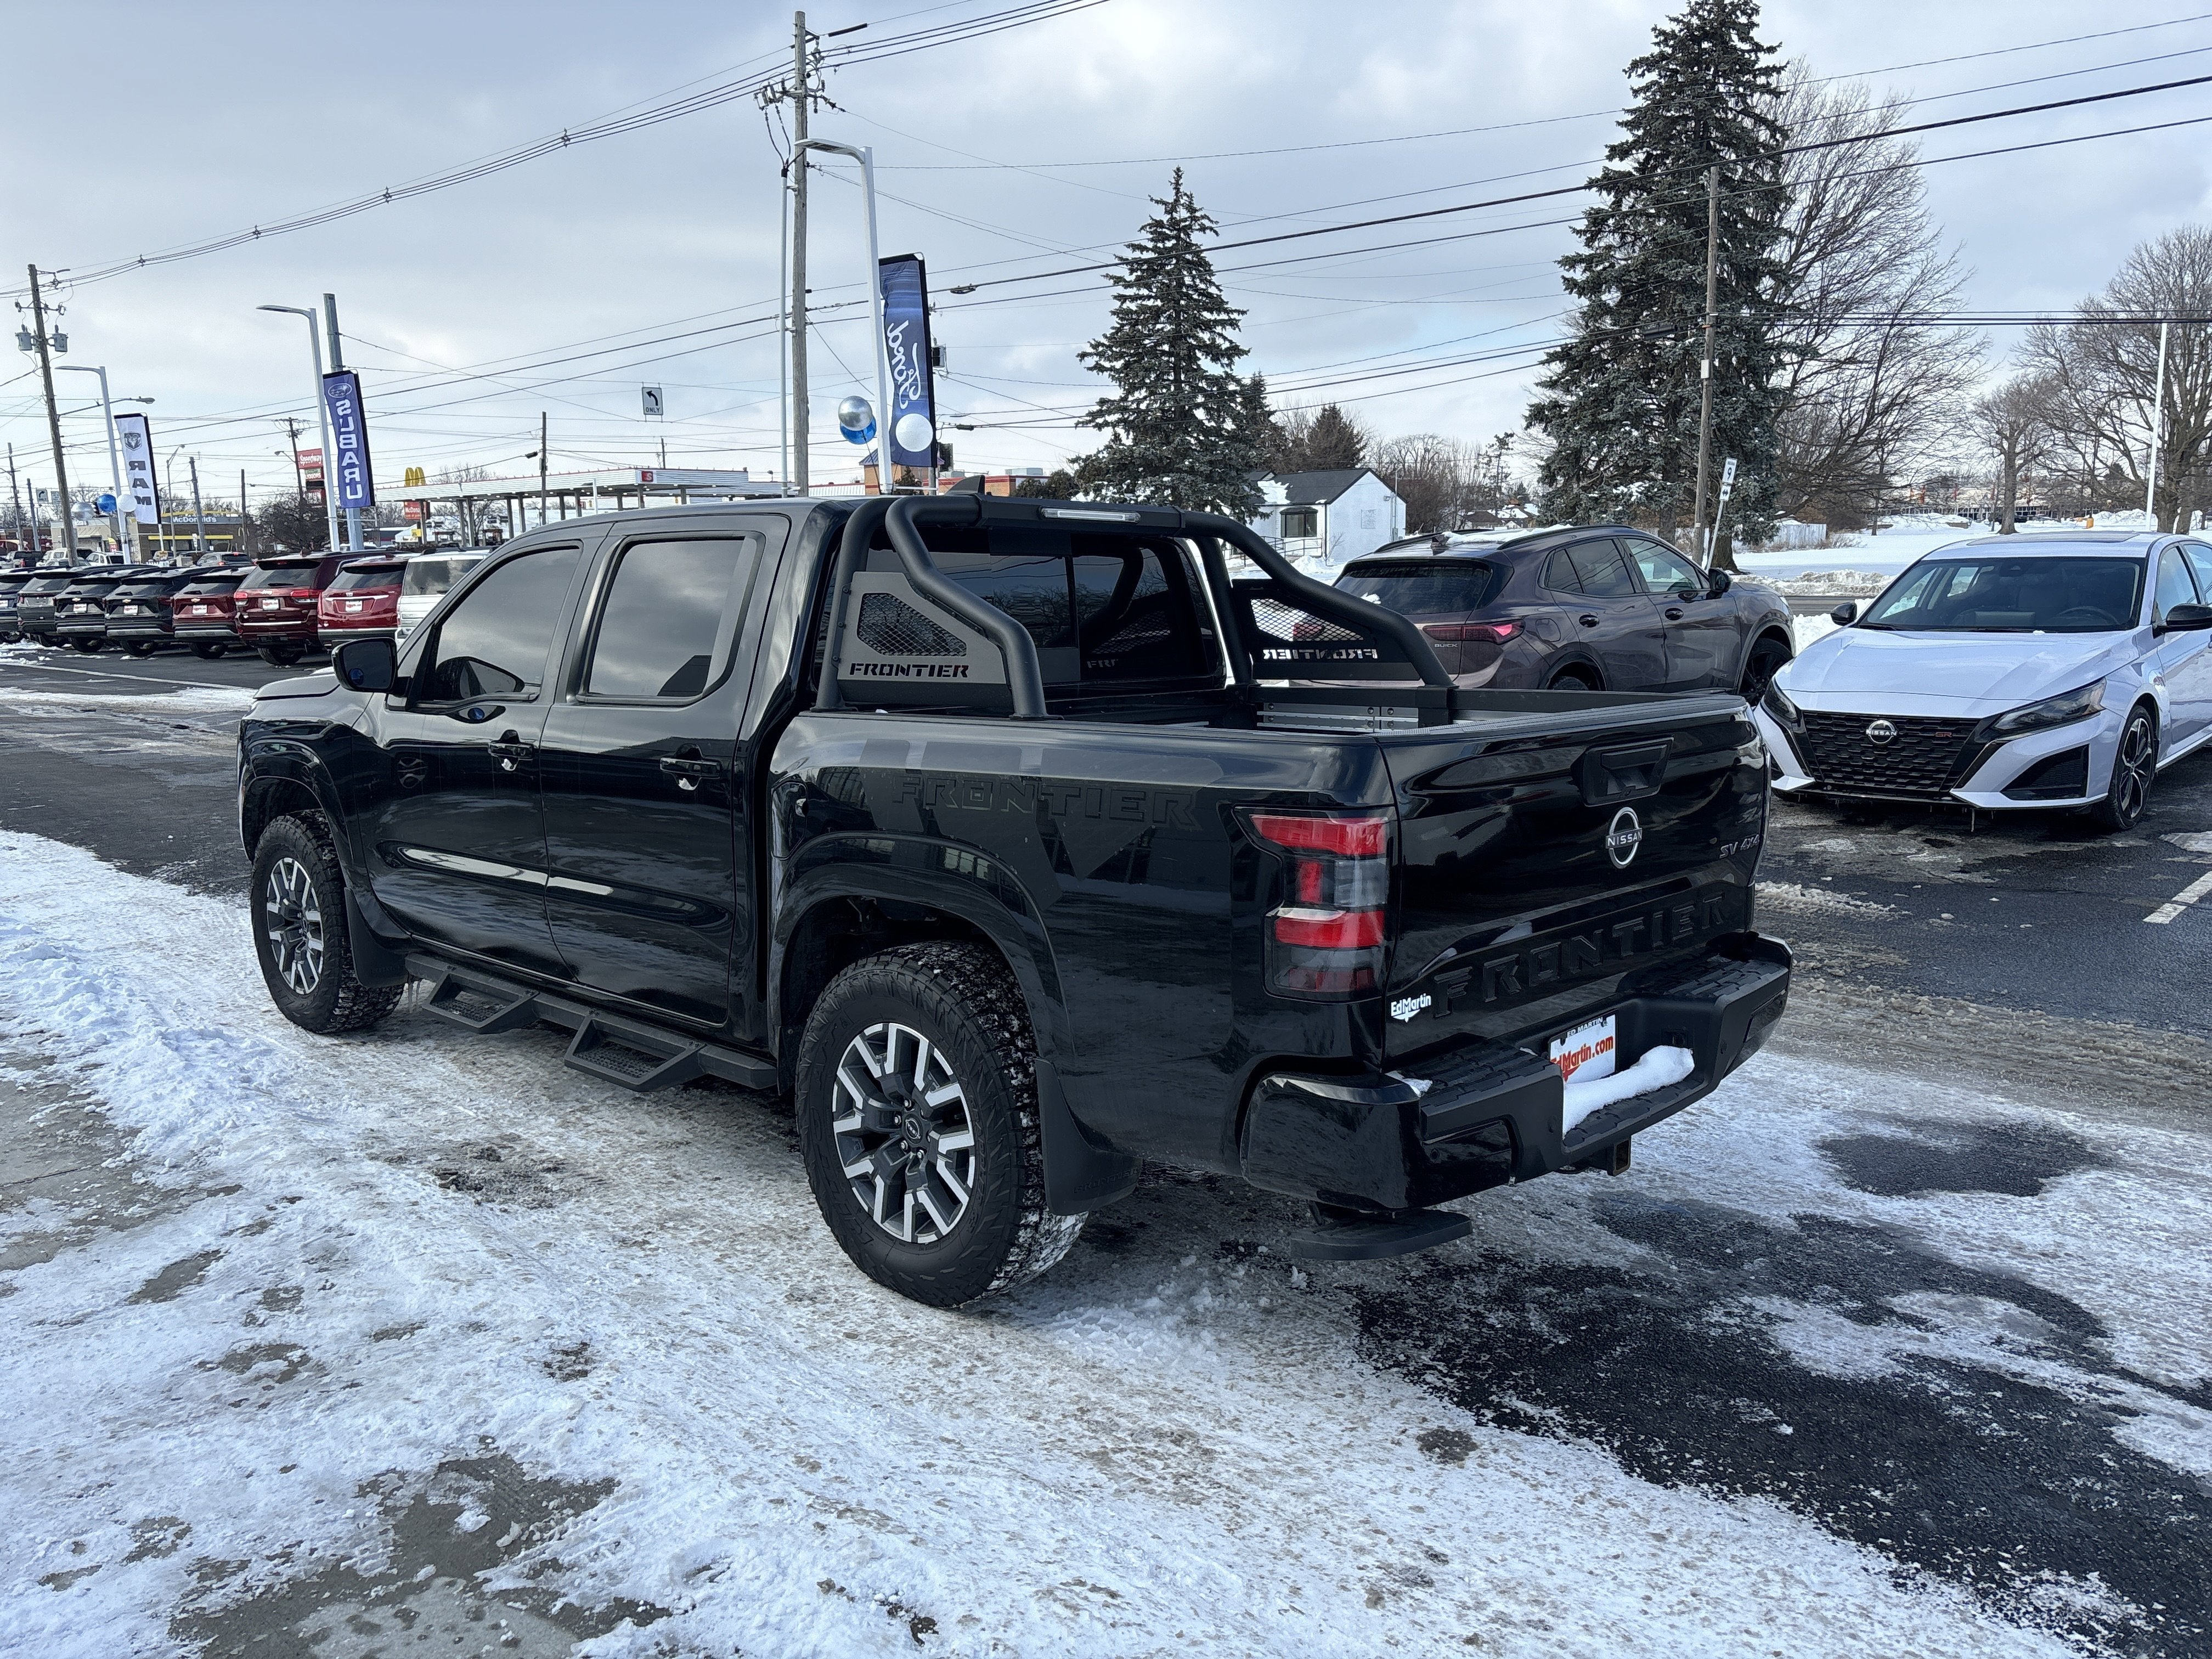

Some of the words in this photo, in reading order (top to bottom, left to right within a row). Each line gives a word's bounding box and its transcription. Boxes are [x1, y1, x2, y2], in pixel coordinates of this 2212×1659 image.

[300, 454, 322, 466] Speedway
[1727, 467, 1733, 481] 9
[850, 662, 969, 679] FRONTIER
[892, 775, 1203, 831] FRONTIER
[1607, 831, 1642, 847] NISSAN
[1719, 841, 1739, 859] SV
[1433, 891, 1727, 1019] FRONTIER
[1391, 993, 1431, 1017] EdMartin
[1567, 1029, 1576, 1038] ED
[1577, 1017, 1603, 1033] MARTIN
